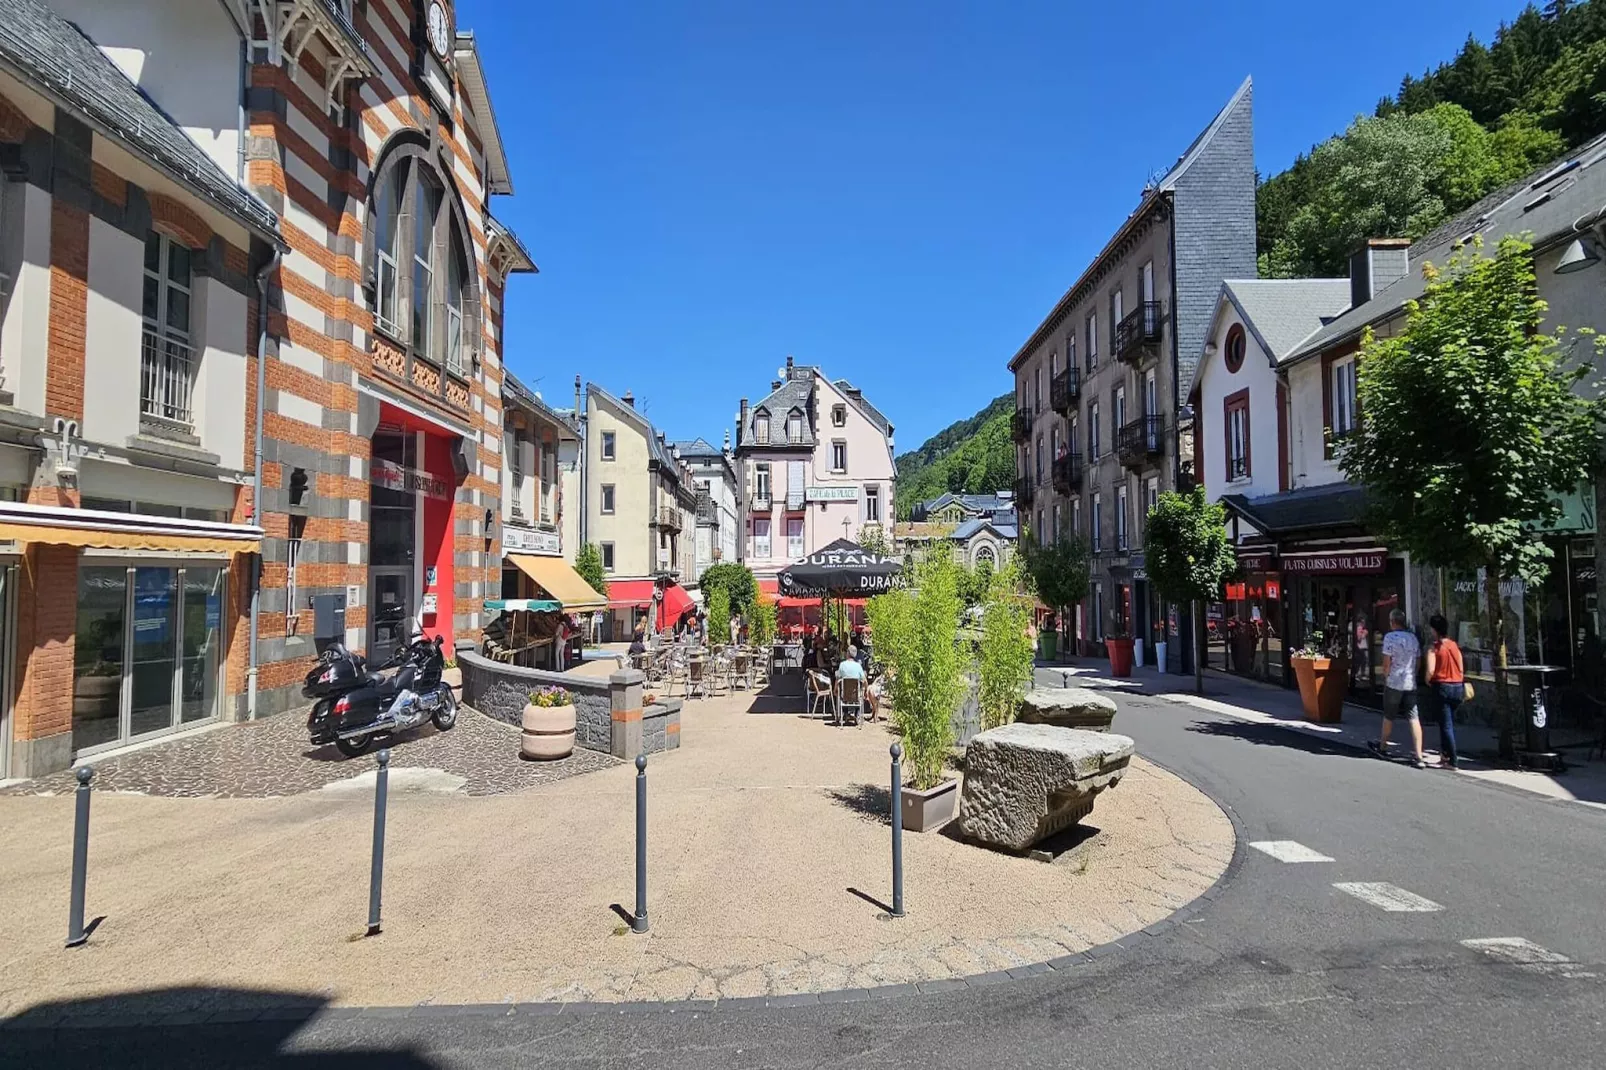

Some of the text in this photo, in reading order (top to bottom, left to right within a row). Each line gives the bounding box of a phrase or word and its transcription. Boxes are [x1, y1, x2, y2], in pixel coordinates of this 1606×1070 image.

[1284, 559, 1306, 570] PLATS
[1339, 556, 1382, 569] VOLAILLES
[861, 575, 907, 588] DURANA
[1454, 581, 1477, 592] JACKY
